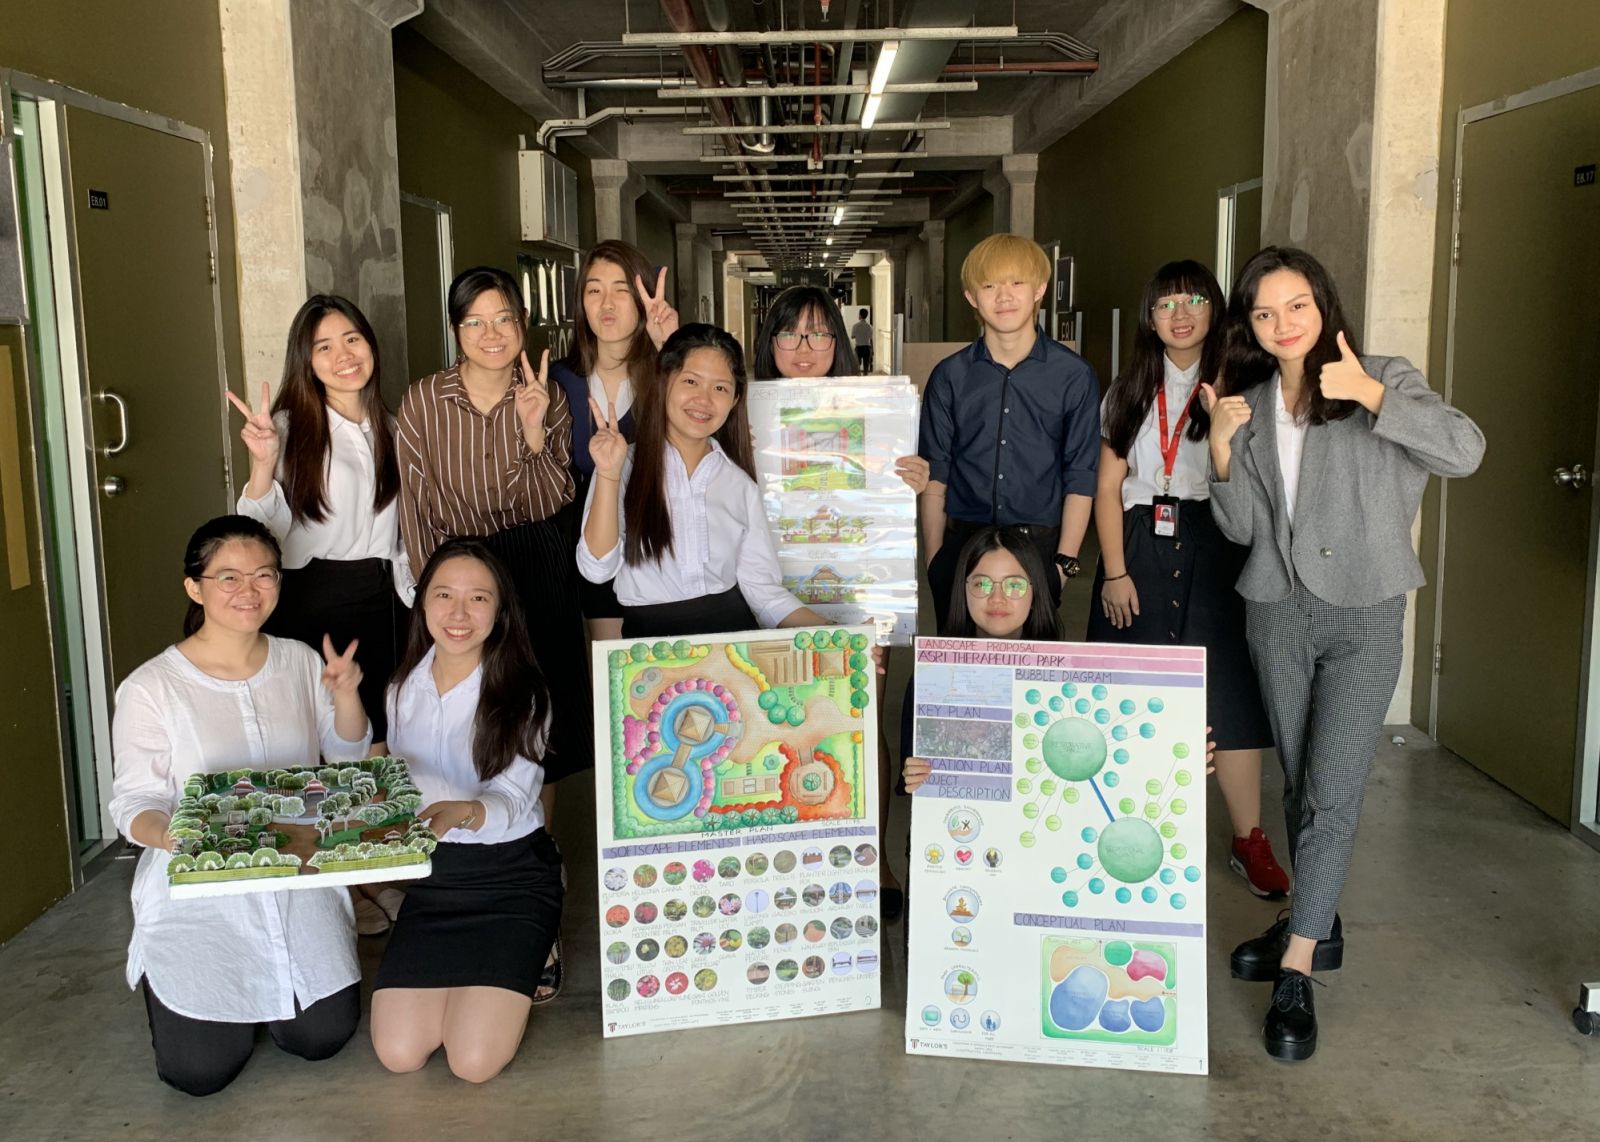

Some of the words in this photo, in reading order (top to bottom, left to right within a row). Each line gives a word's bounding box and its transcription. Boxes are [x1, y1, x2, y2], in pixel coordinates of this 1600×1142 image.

[918, 639, 977, 651] LANDSCAPE
[986, 641, 1037, 653] PROPOSAL
[918, 650, 947, 663] ASRI
[952, 652, 1031, 666] THERAPEUTIC
[1037, 655, 1065, 667] PARK
[1015, 668, 1056, 682] BUBBLE
[1062, 671, 1112, 684] DIAGRAM
[918, 703, 942, 717] KEY
[948, 705, 982, 718] PLAN
[929, 758, 974, 771] CATION
[979, 762, 1010, 774] PLAN
[938, 785, 1010, 800] DESCRIPTION
[701, 828, 743, 839] MASTER
[747, 831, 808, 845] HARDSCAPE
[812, 826, 867, 840] ELEMENTS
[610, 842, 673, 859] SOFTSCAPE
[677, 837, 735, 853] ELEMENTS
[1014, 912, 1087, 930] CONCEPTUAL
[1094, 919, 1126, 932] PLAN
